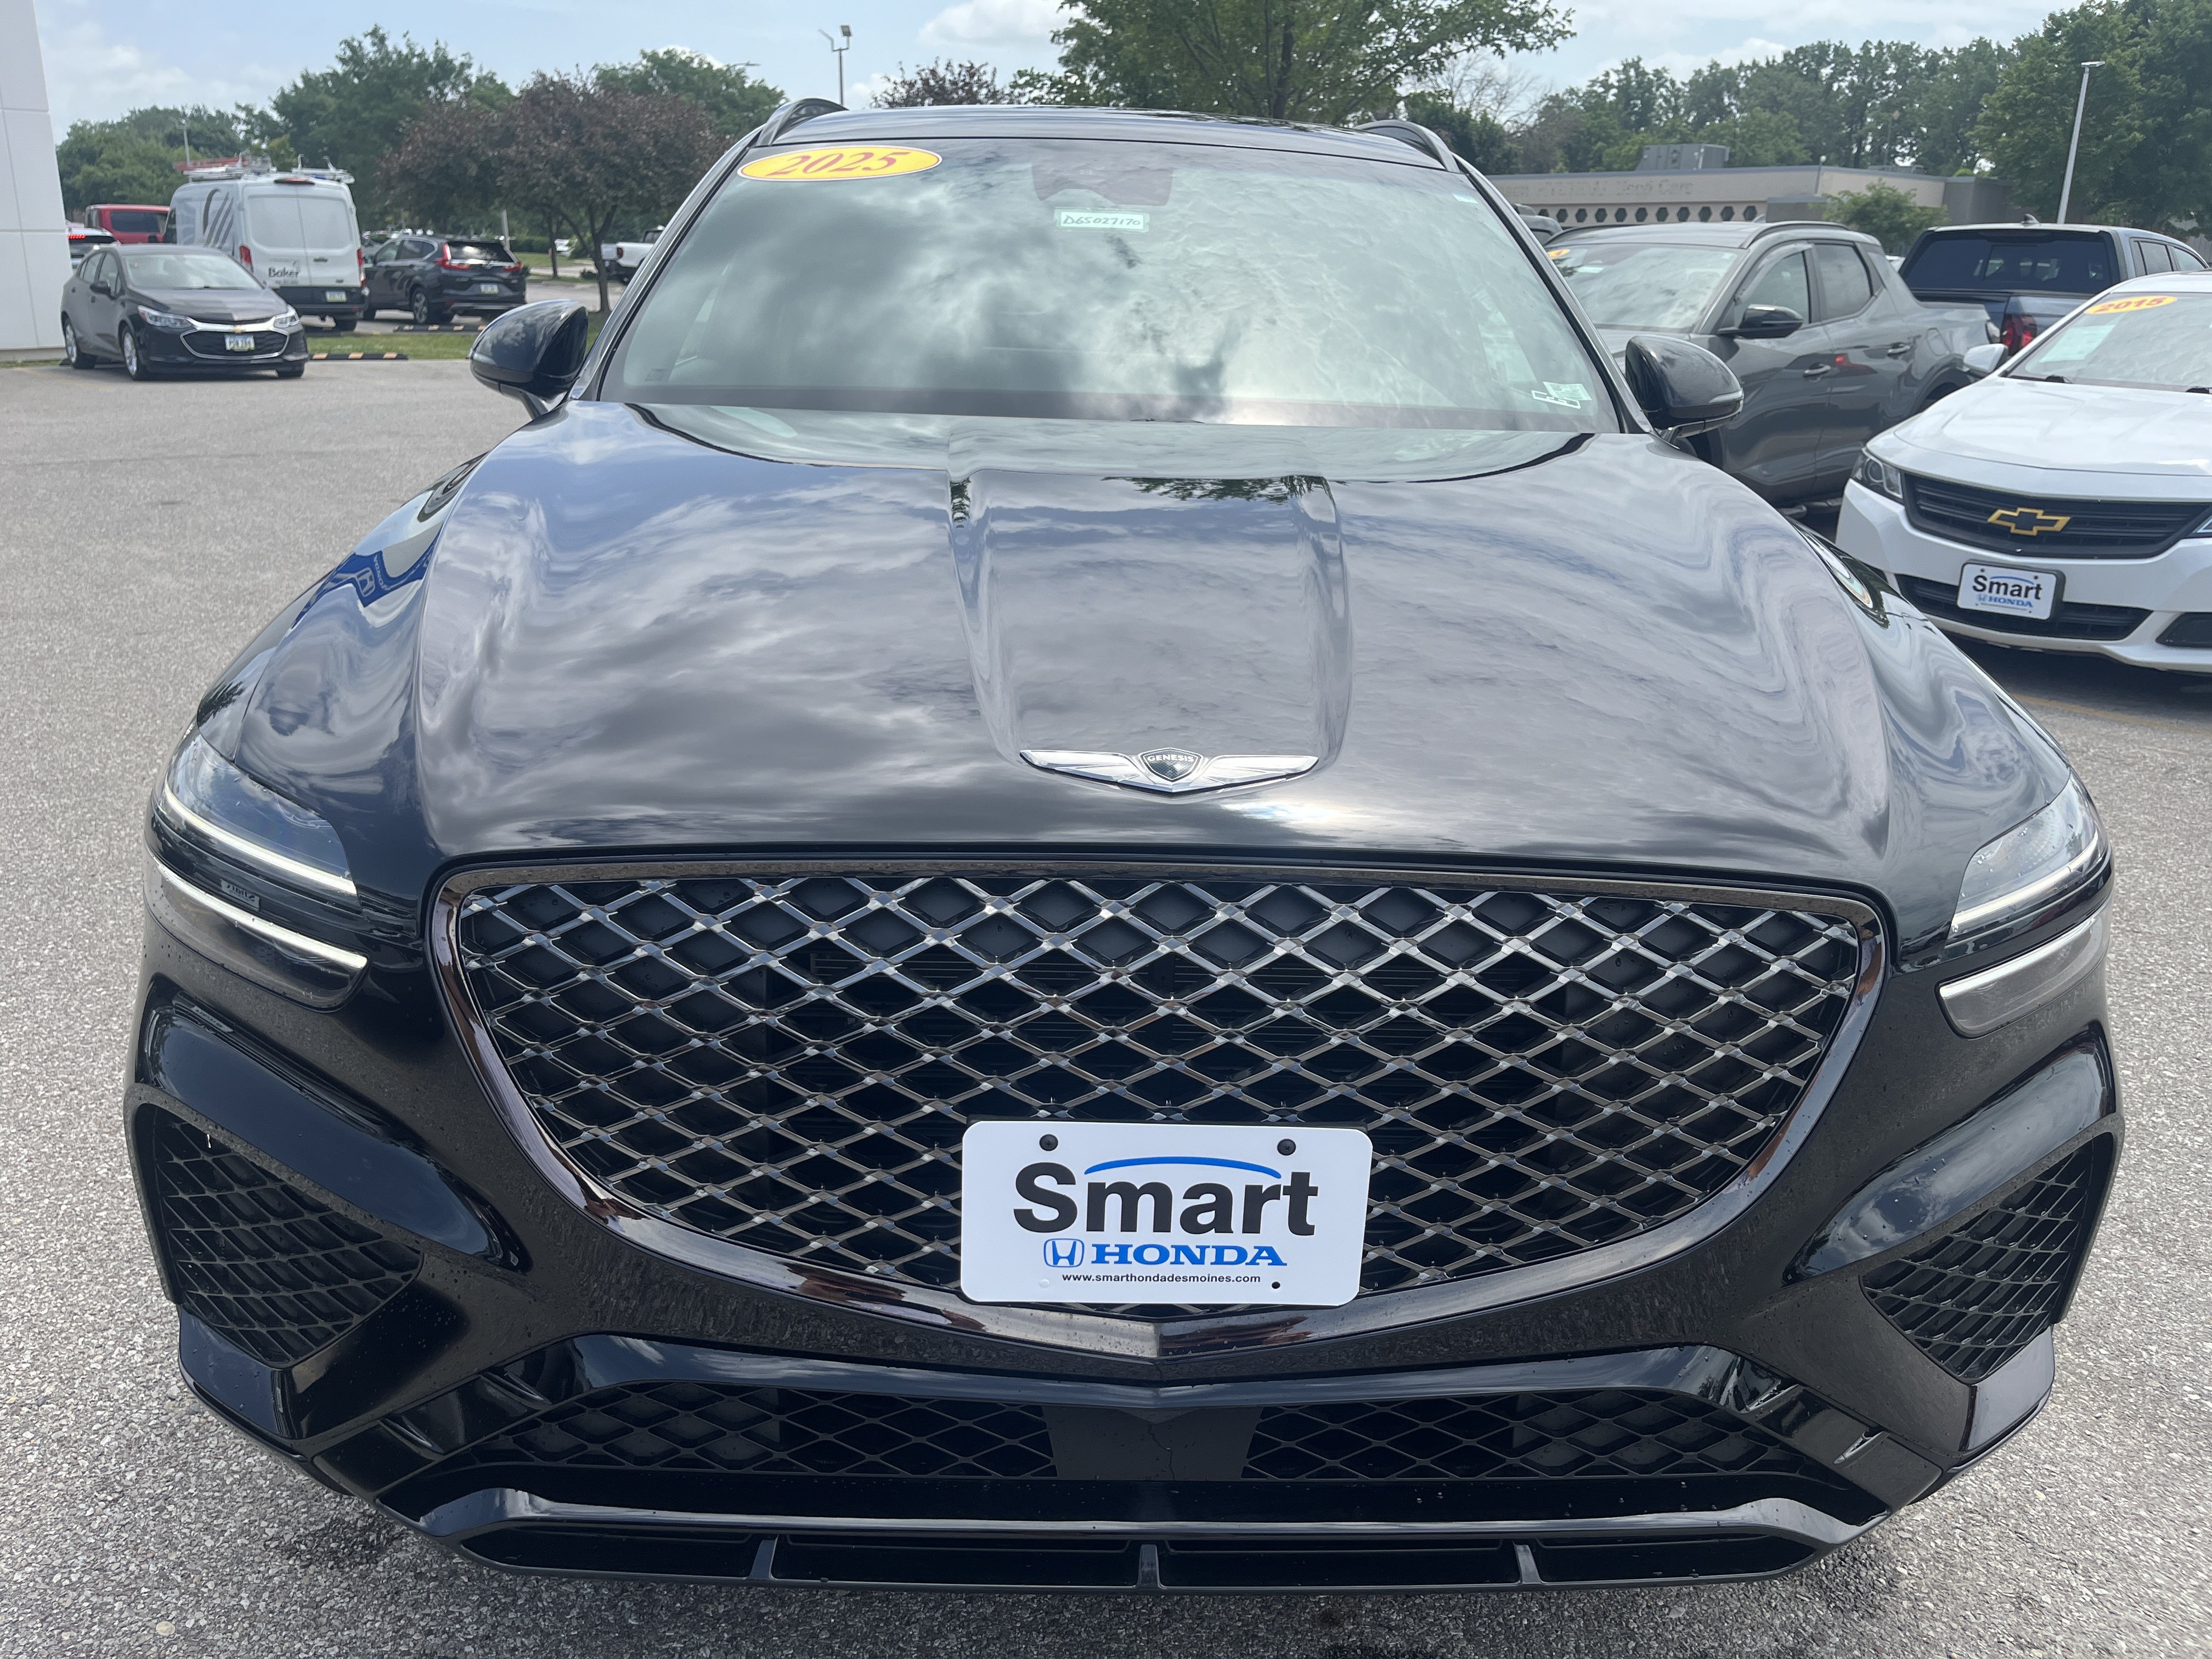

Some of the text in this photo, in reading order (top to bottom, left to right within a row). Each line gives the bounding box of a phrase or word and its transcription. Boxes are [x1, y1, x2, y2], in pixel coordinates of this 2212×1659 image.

[765, 151, 911, 176] 2025
[268, 267, 298, 278] Baker
[2095, 297, 2168, 313] 2015
[1973, 575, 2042, 600] Smart
[1989, 596, 2033, 607] HONDA
[1013, 1162, 1318, 1236] Smart
[1092, 1243, 1288, 1266] HONDA
[1062, 1272, 1261, 1284] www.smarthondadesmoines.com
